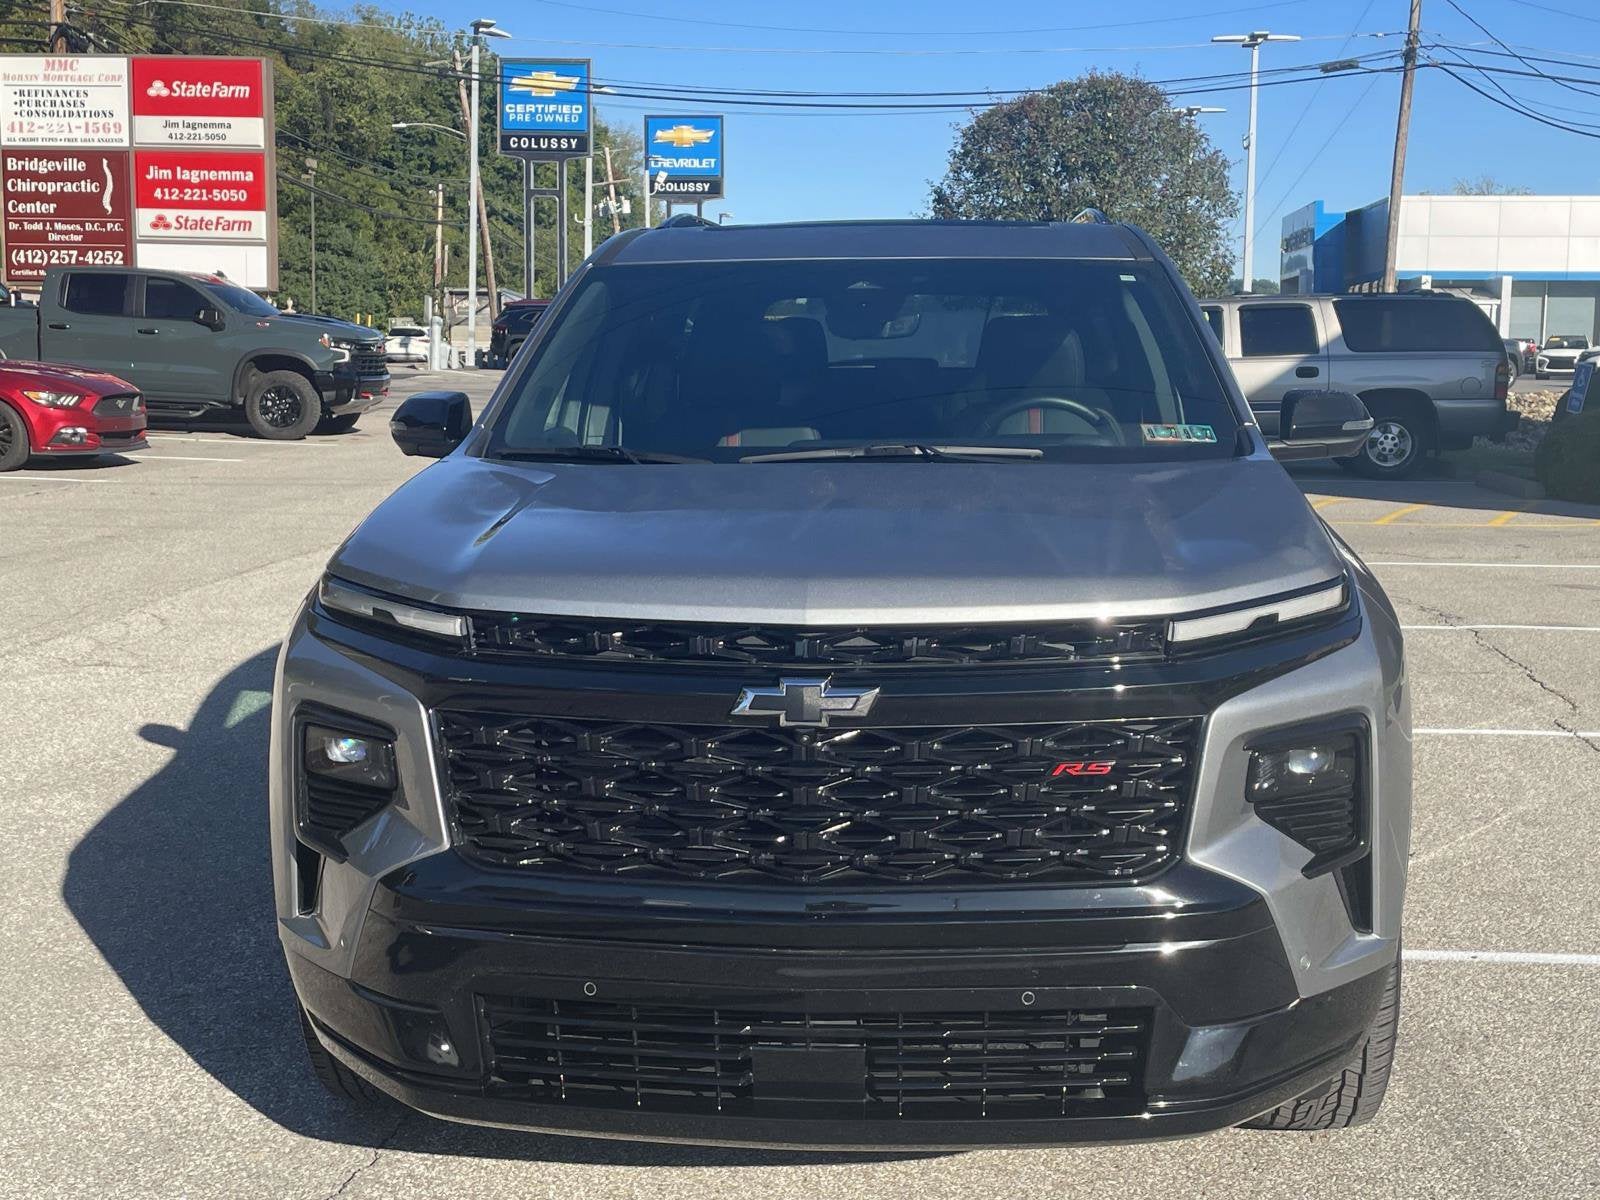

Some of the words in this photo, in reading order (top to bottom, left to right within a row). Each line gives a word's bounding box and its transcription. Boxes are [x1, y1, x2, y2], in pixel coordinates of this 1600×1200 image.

[44, 59, 80, 72] MMC
[42, 74, 94, 83] MORTGAGE
[19, 89, 89, 98] REFINANCES
[19, 99, 86, 108] PURCHASES
[505, 103, 583, 113] CERTIFIED
[19, 109, 115, 119] CONSOLIDATIONS
[509, 113, 579, 123] PRE-OWNED
[7, 121, 123, 134] 412-221-1569
[162, 120, 179, 129] Jim
[168, 132, 227, 141] 412-221-5050
[510, 137, 578, 149] COLUSSY
[6, 157, 87, 174] Bridgeville
[145, 165, 173, 180] Jim
[6, 178, 100, 195] Chiropractic
[658, 182, 710, 192] COLUSSY
[153, 187, 248, 202] 412-221-5050
[7, 199, 57, 214] Center
[8, 221, 22, 231] Dr.
[23, 221, 43, 231] Todd
[48, 233, 83, 242] Director
[11, 249, 48, 266] (412)
[49, 250, 124, 265] 257-4252
[1051, 761, 1116, 776] RS
